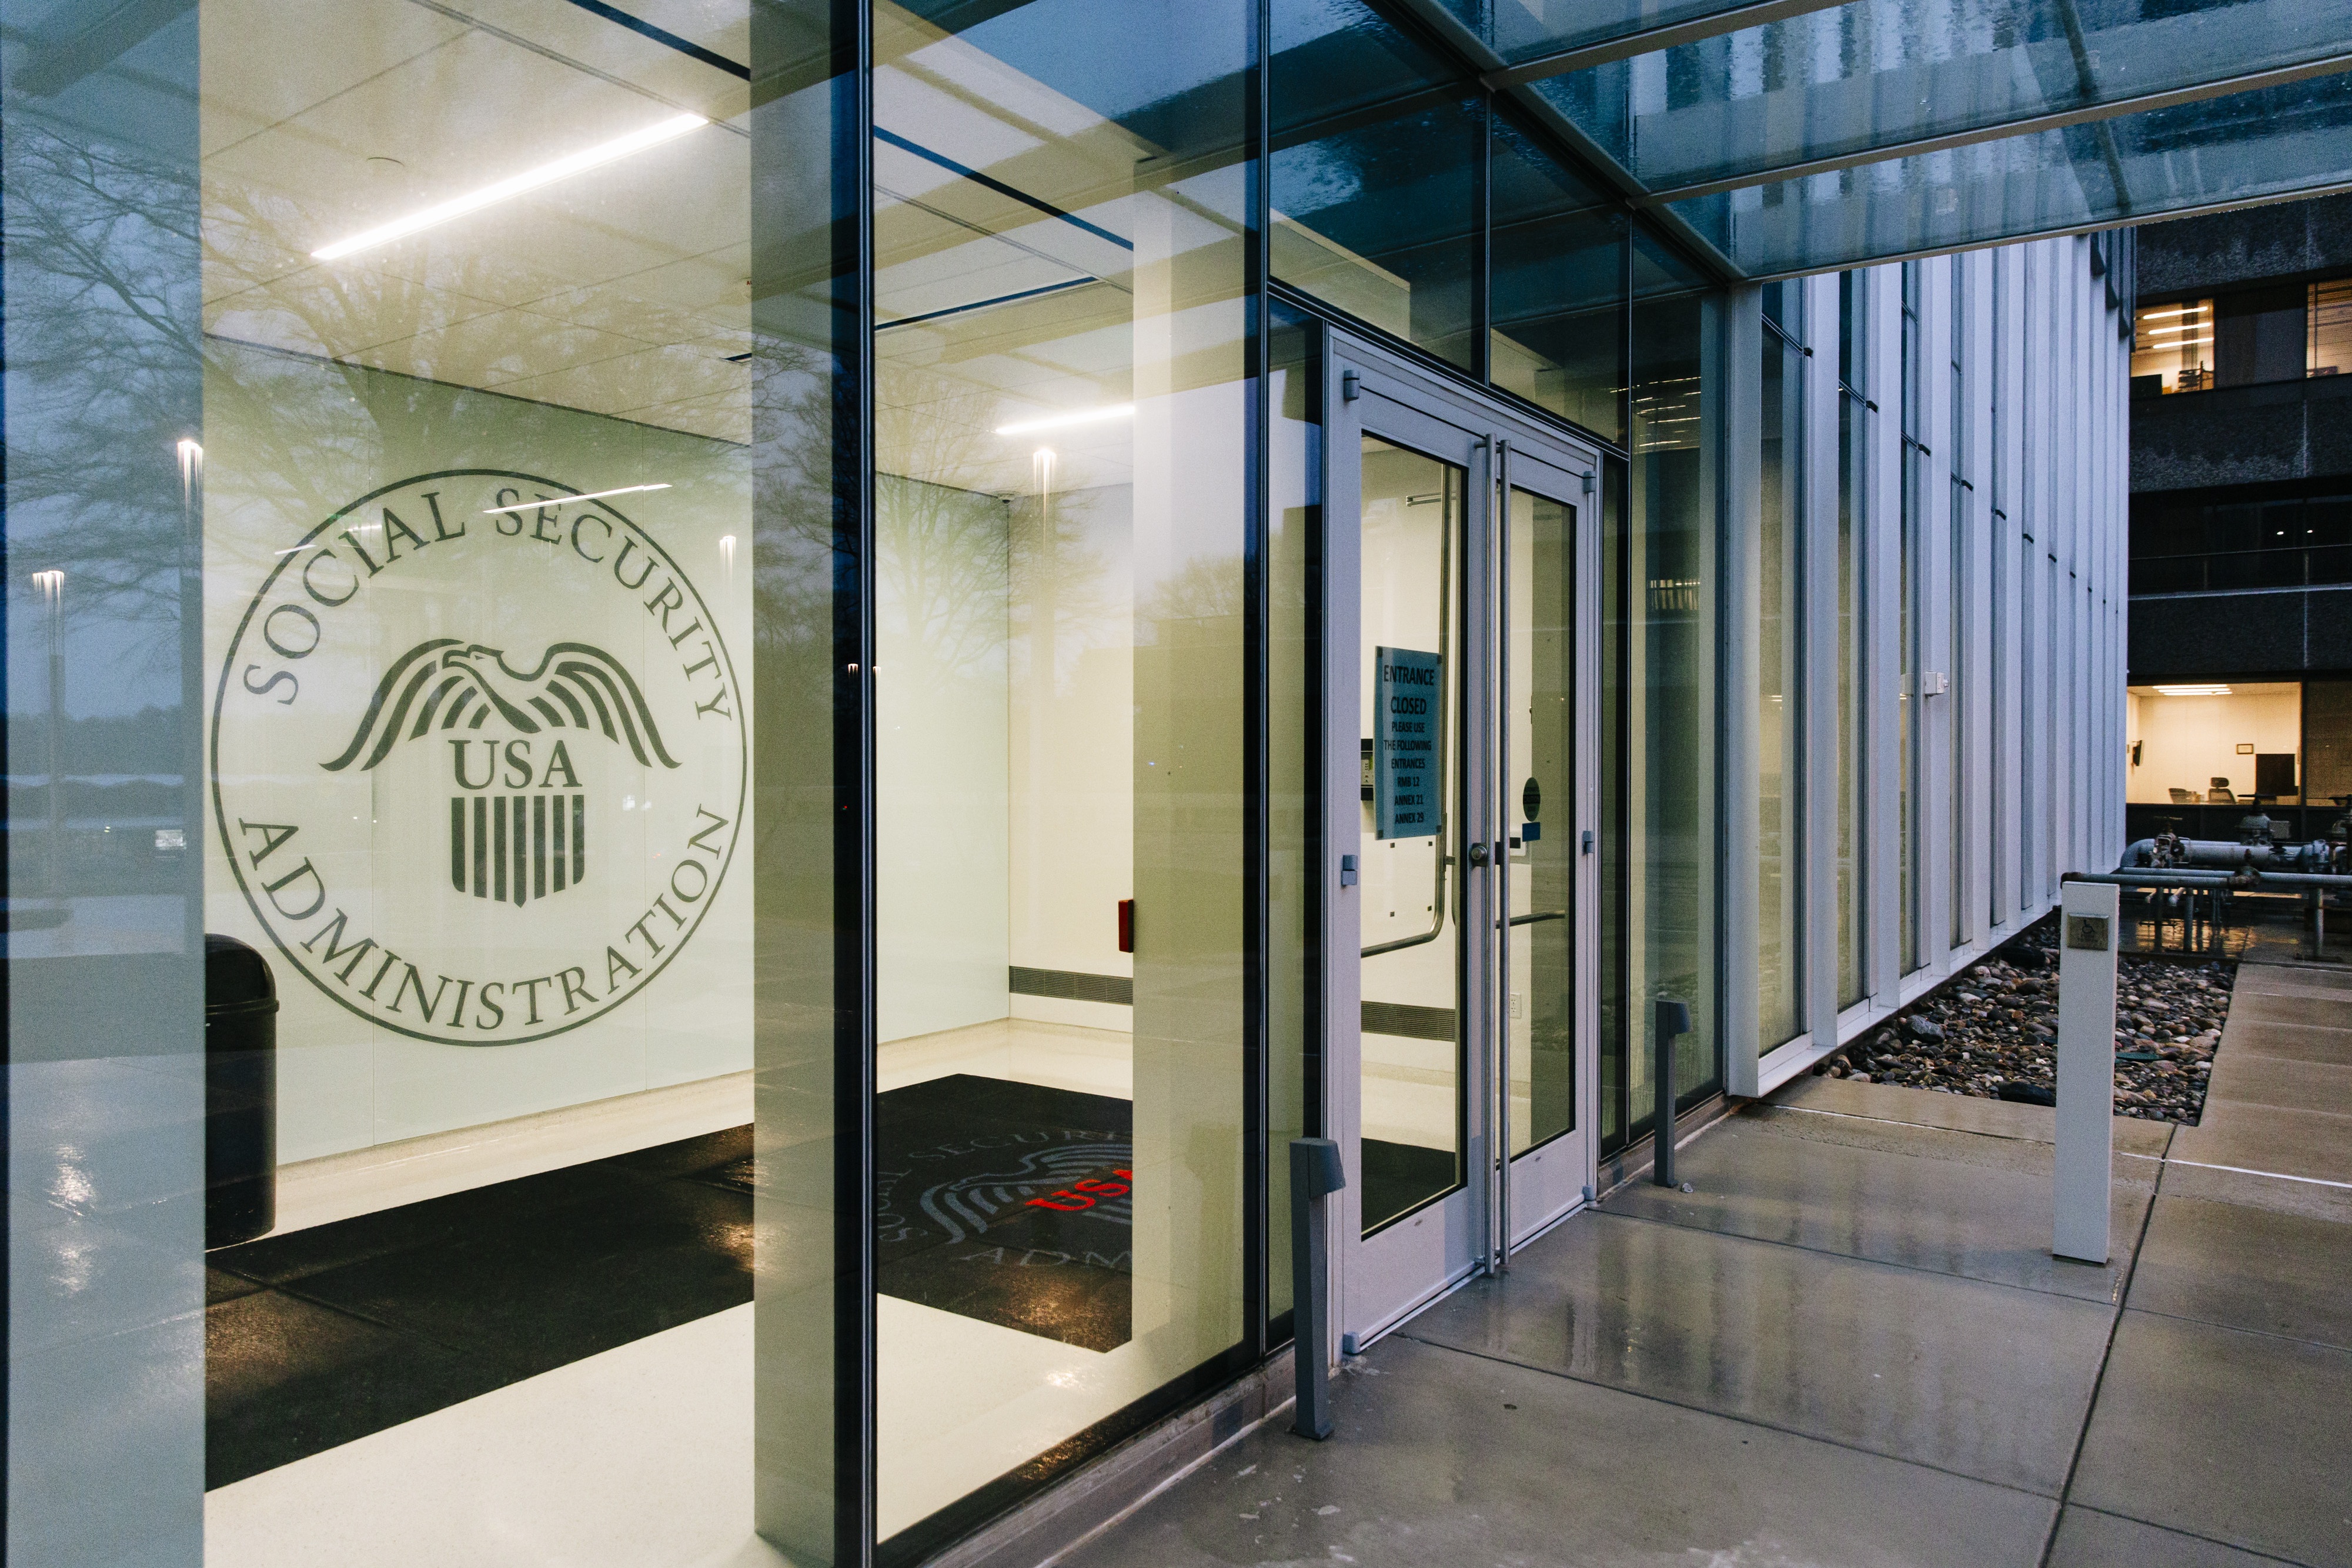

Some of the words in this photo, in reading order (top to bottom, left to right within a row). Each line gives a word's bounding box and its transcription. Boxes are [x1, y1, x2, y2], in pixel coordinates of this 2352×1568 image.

[242, 492, 466, 705] SOCIAL
[495, 487, 733, 721] SECURITY
[1384, 664, 1435, 686] ENTRANCE
[1391, 696, 1427, 715] CLOSED
[1391, 721, 1412, 733] PLEASE
[1414, 722, 1425, 733] USE
[1384, 740, 1396, 751] THE
[1397, 740, 1432, 751] FOLLOWING
[448, 739, 583, 790] USA
[1391, 758, 1425, 769] ENTRANCES
[1397, 777, 1411, 787] RMB
[1412, 777, 1420, 787] 12
[1394, 794, 1415, 806] ANNEX
[1416, 794, 1424, 805] 21
[1395, 813, 1416, 824] ANNEX
[1416, 812, 1424, 823] 29
[238, 803, 730, 1030] ADMINISTRATION
[908, 1130, 1132, 1161] SECURI
